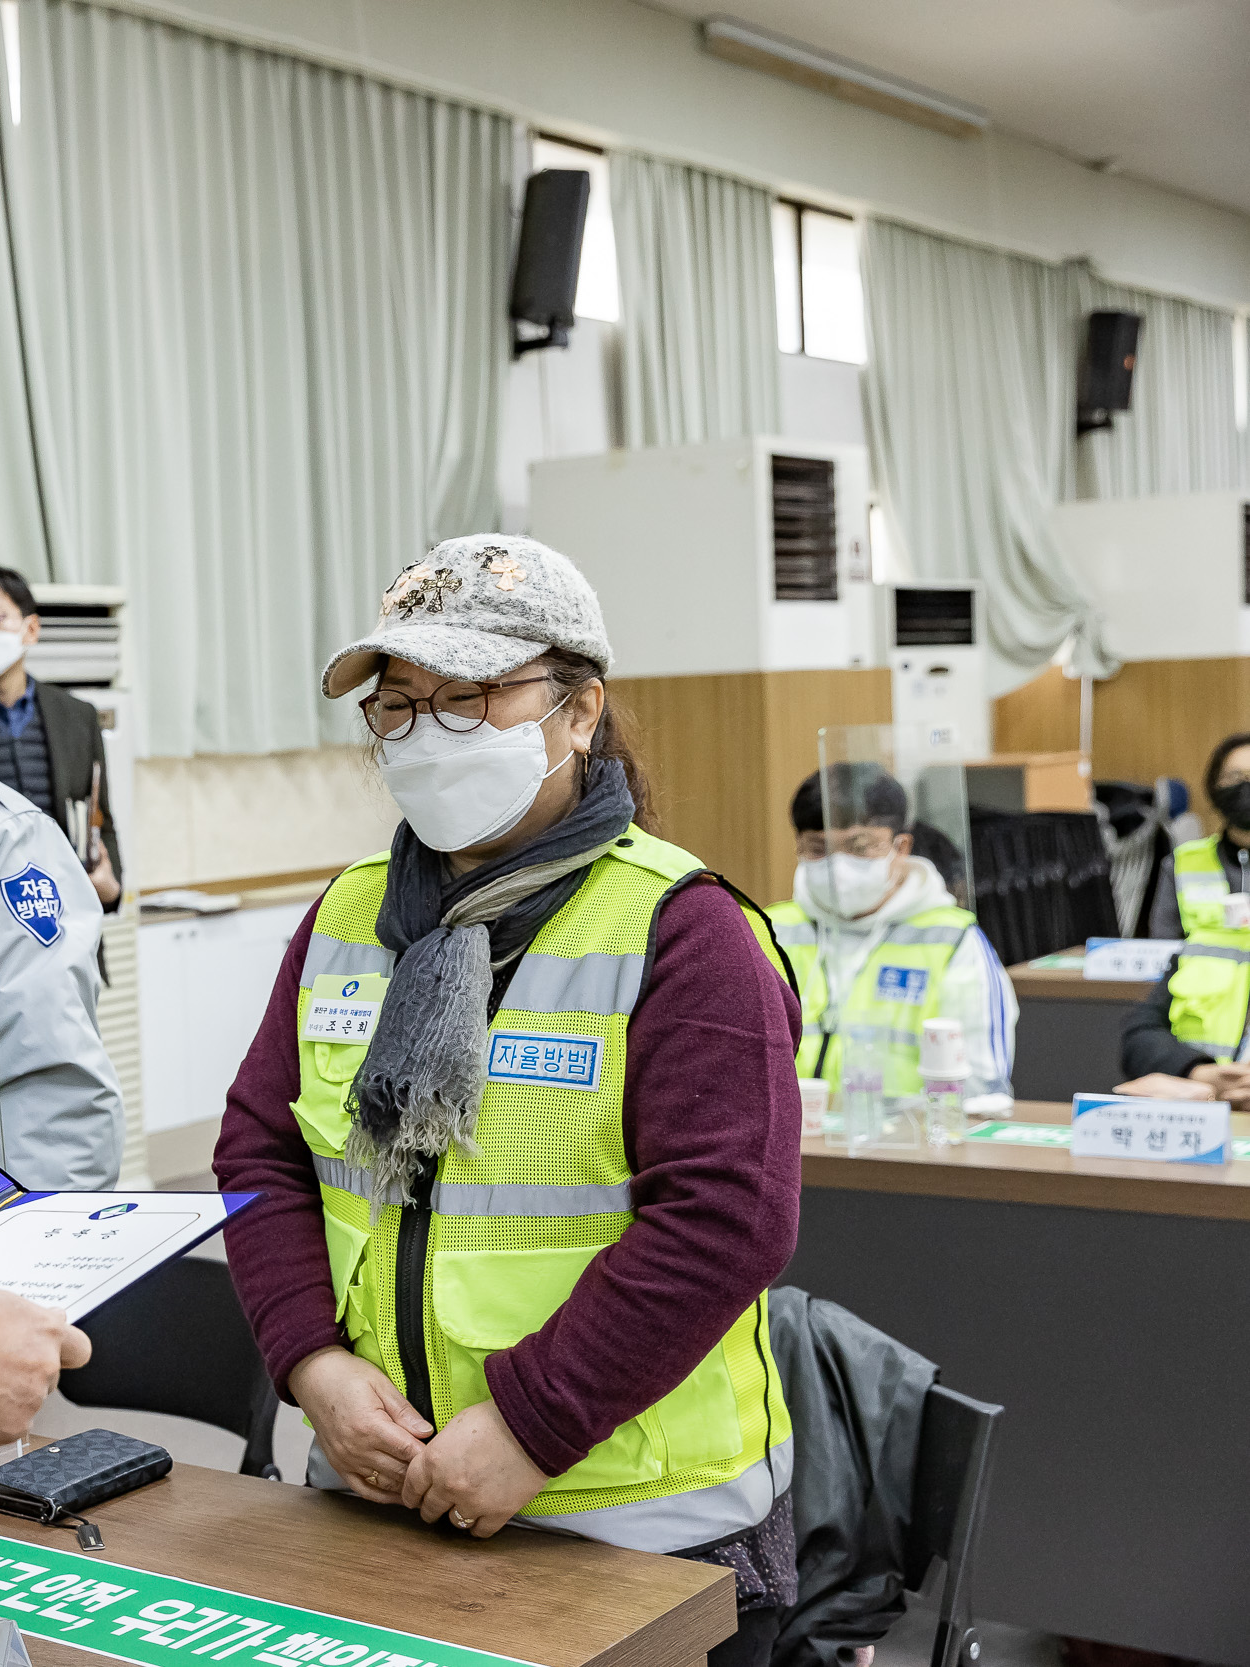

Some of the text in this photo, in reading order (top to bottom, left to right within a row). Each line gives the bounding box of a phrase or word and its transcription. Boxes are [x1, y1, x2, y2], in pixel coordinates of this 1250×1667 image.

[19, 878, 55, 899] 자율
[497, 1044, 588, 1076] 자율방범
[110, 1598, 286, 1662] 우리가
